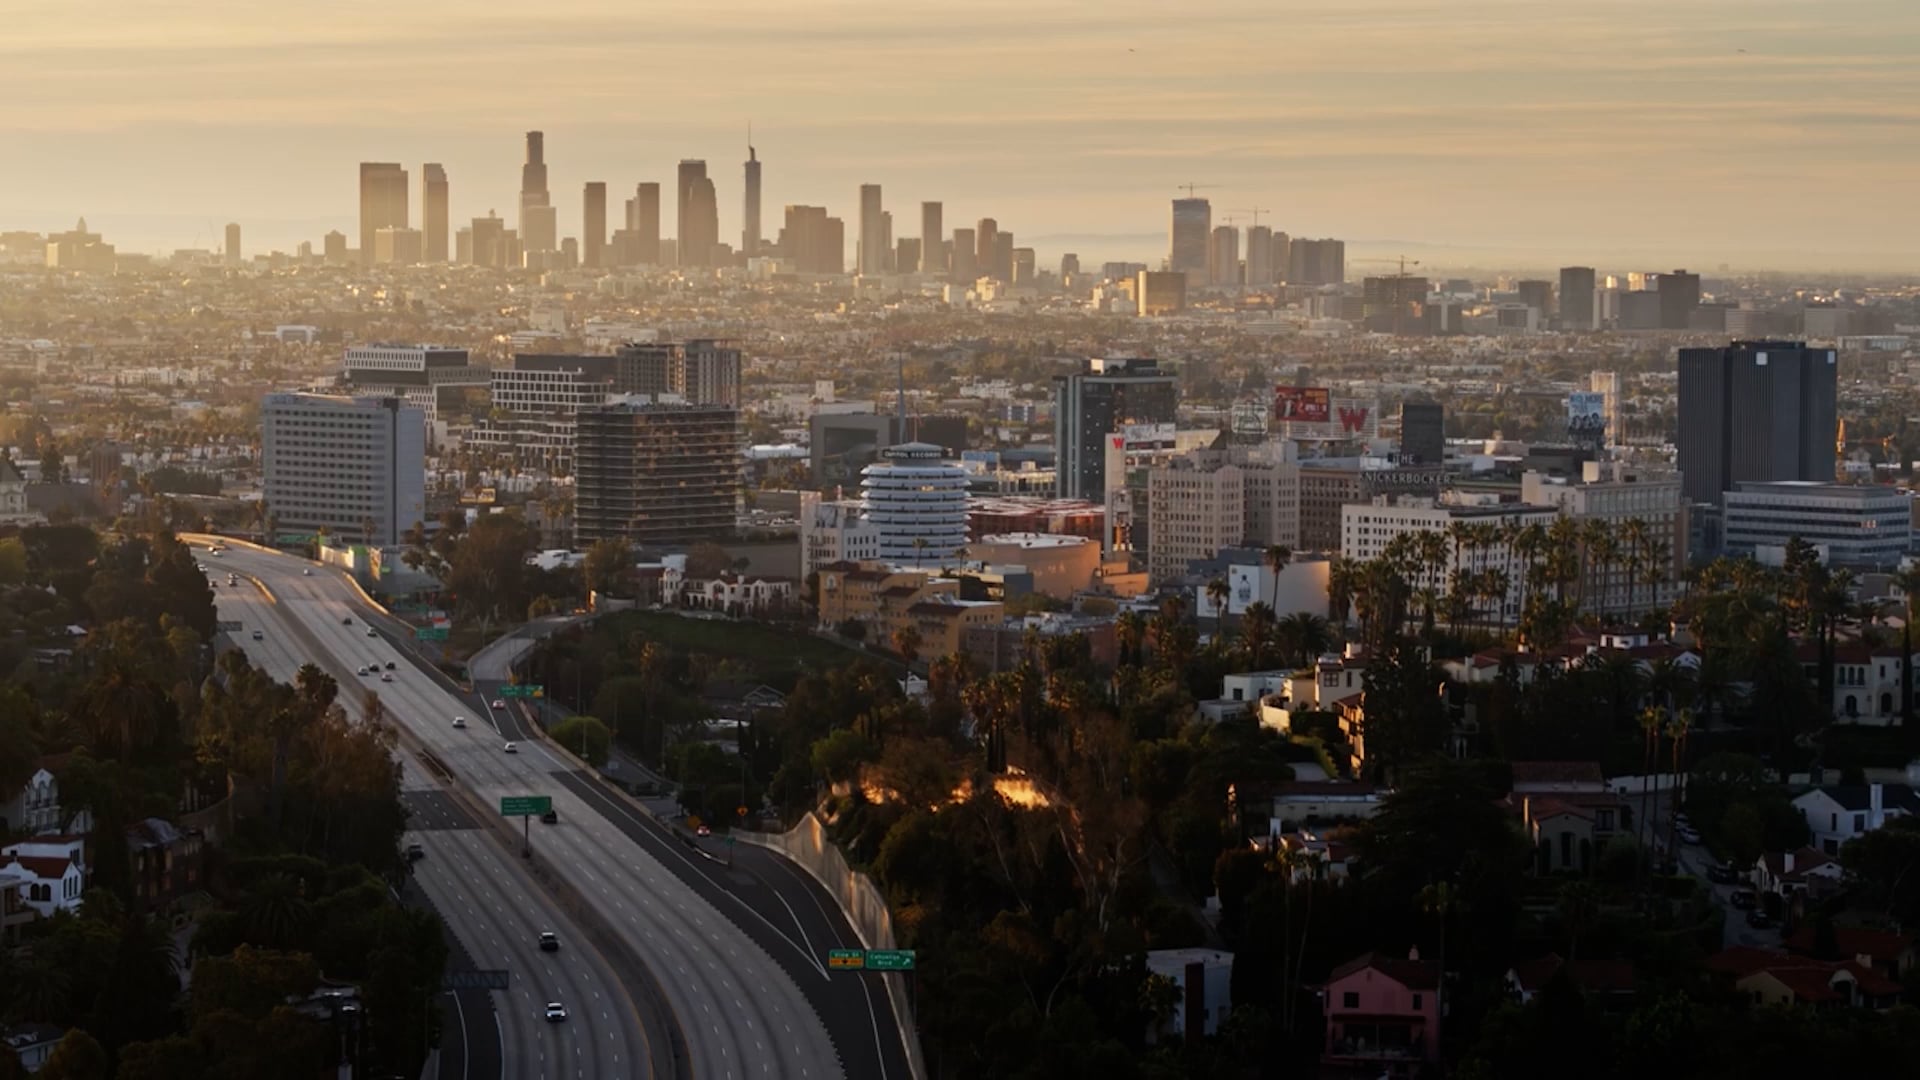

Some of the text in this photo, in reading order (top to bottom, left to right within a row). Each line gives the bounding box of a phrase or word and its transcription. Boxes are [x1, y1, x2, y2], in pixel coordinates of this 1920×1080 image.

[1338, 407, 1369, 432] W
[1113, 437, 1125, 449] W
[1393, 453, 1415, 464] THE
[1360, 470, 1451, 484] KNICKERBOCKER
